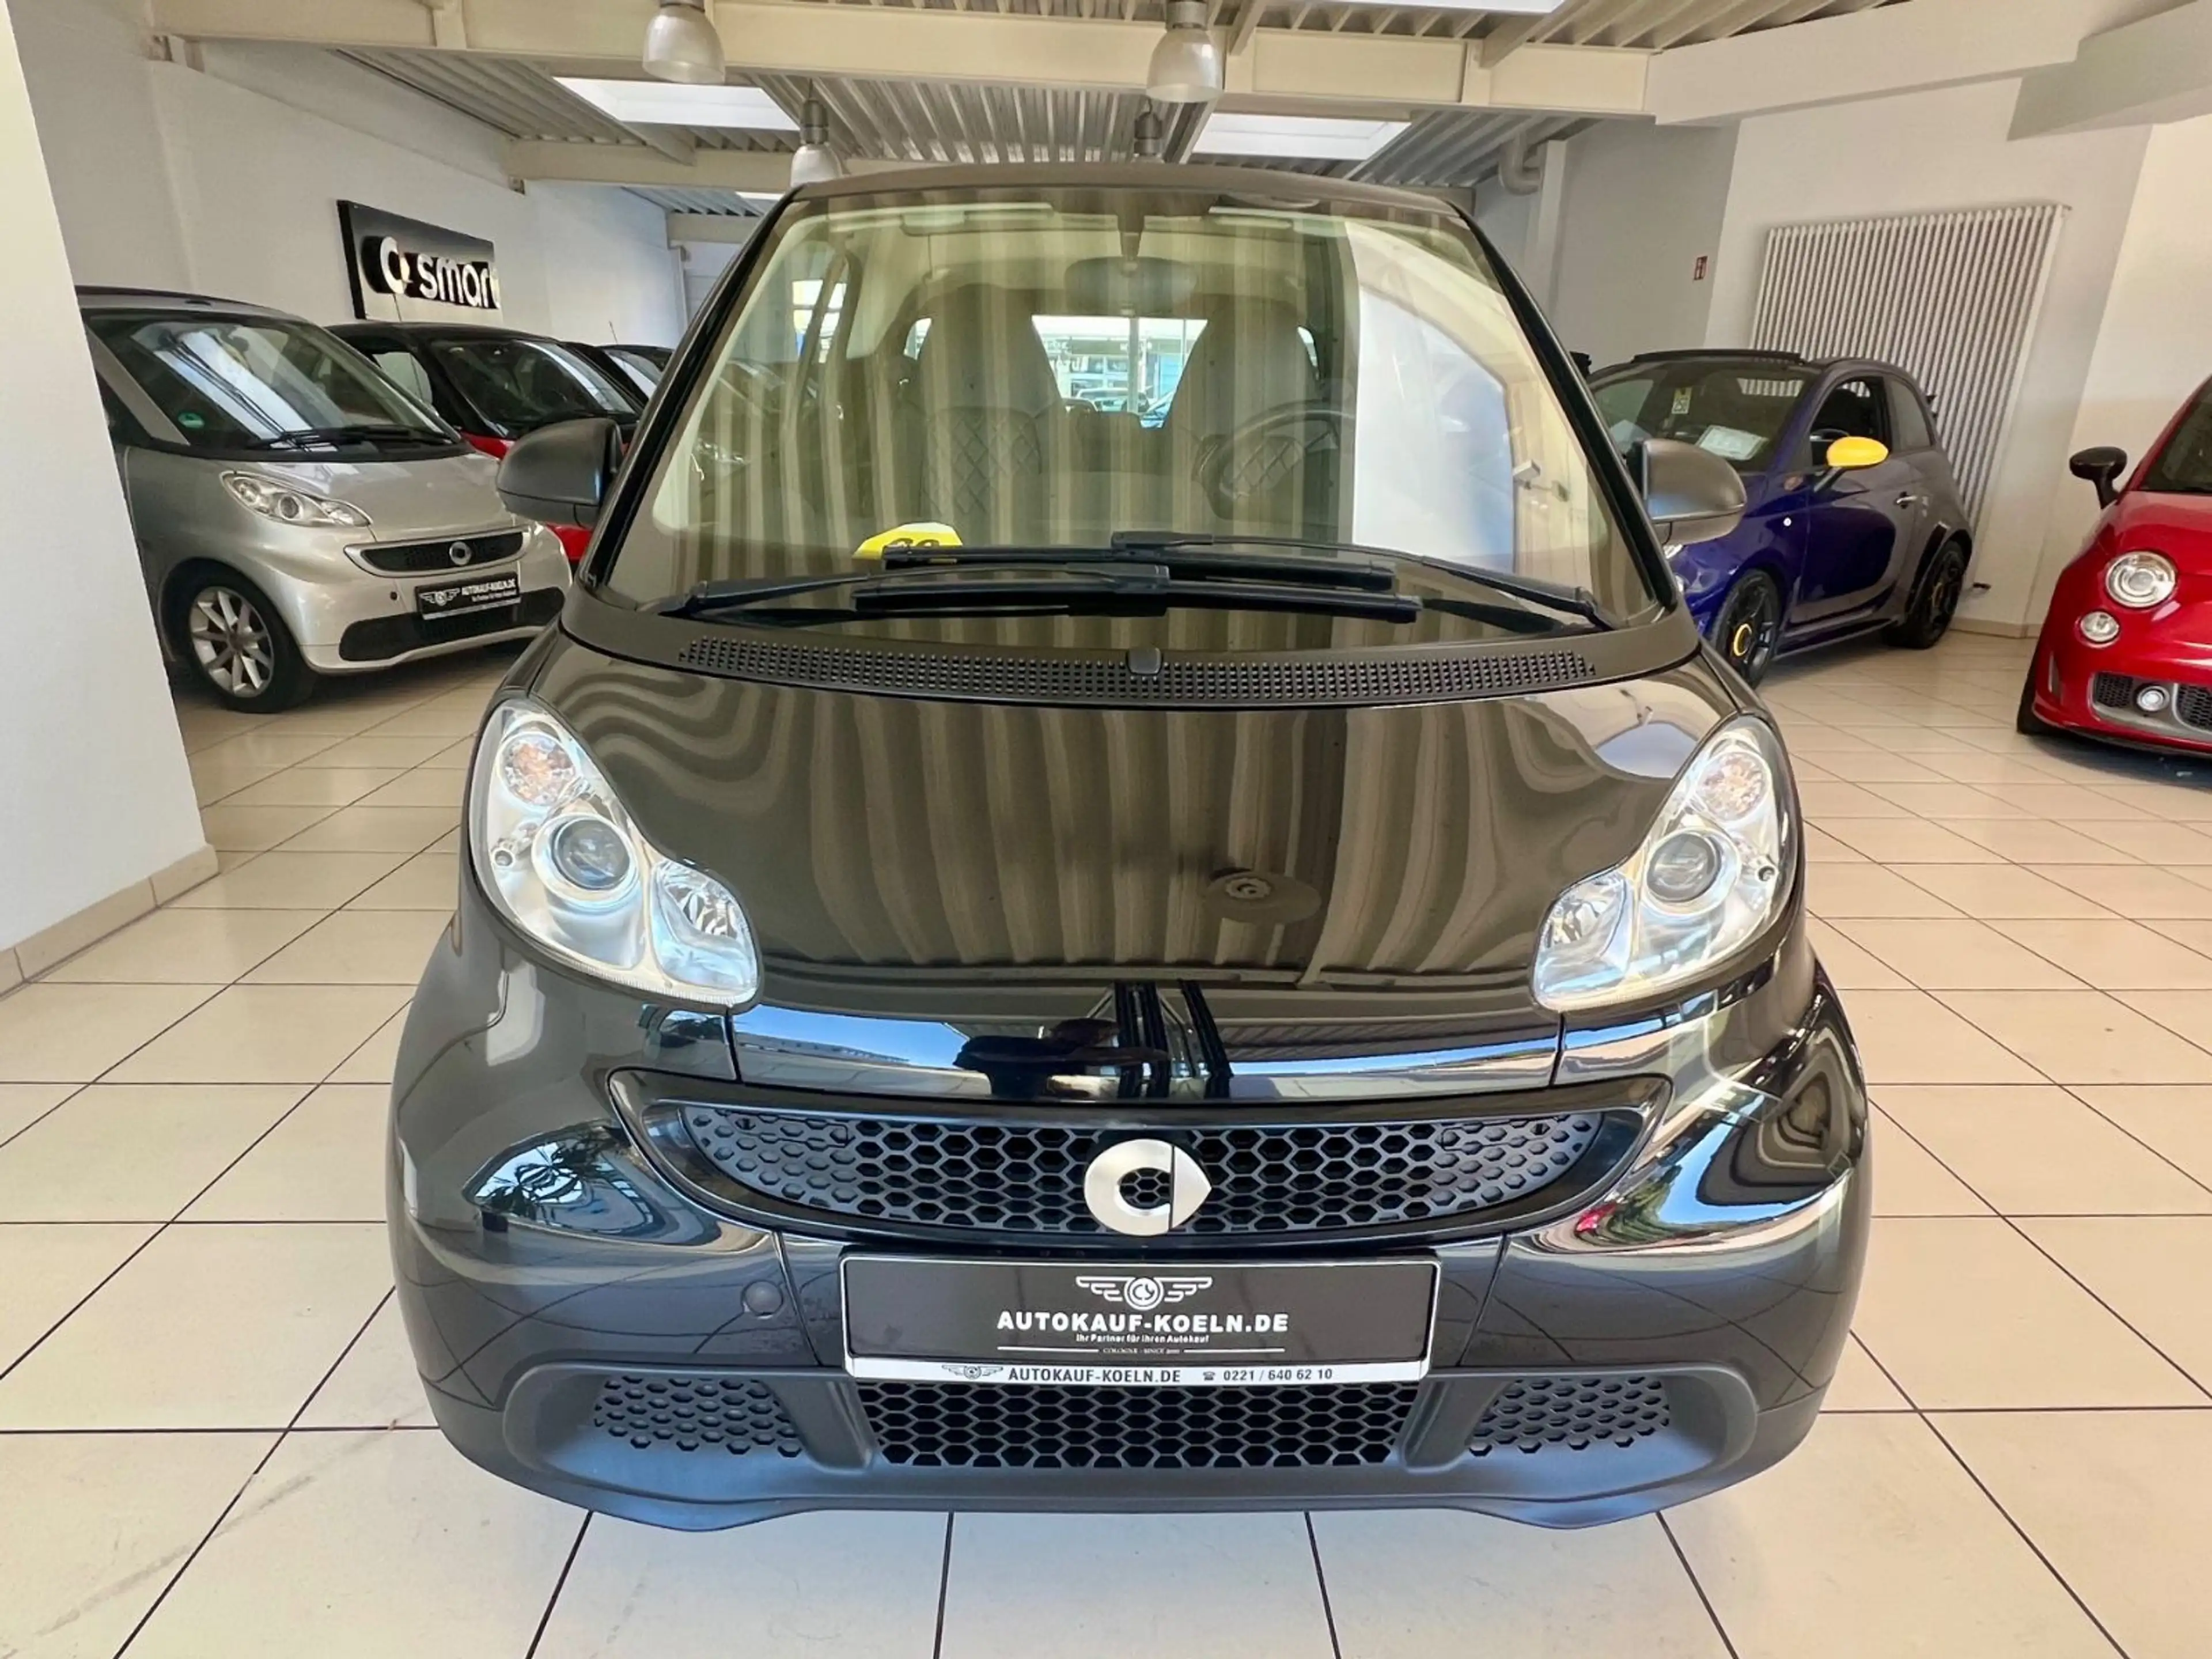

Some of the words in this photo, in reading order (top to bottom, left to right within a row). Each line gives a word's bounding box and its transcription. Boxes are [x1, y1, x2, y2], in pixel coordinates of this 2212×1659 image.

[417, 253, 500, 309] smart
[997, 1310, 1289, 1332] AUTOKAUF-KOELN.DE
[1076, 1334, 1089, 1342] Ihr
[1090, 1334, 1124, 1343] Partner
[1142, 1334, 1165, 1343] Ihren
[1166, 1335, 1209, 1343] Autokauf
[1009, 1368, 1180, 1382] AUTOKAUF-KOELN.DE
[1224, 1370, 1254, 1381] 0221
[1268, 1369, 1292, 1380] 640
[1296, 1369, 1312, 1380] 62
[1318, 1369, 1332, 1379] 10
